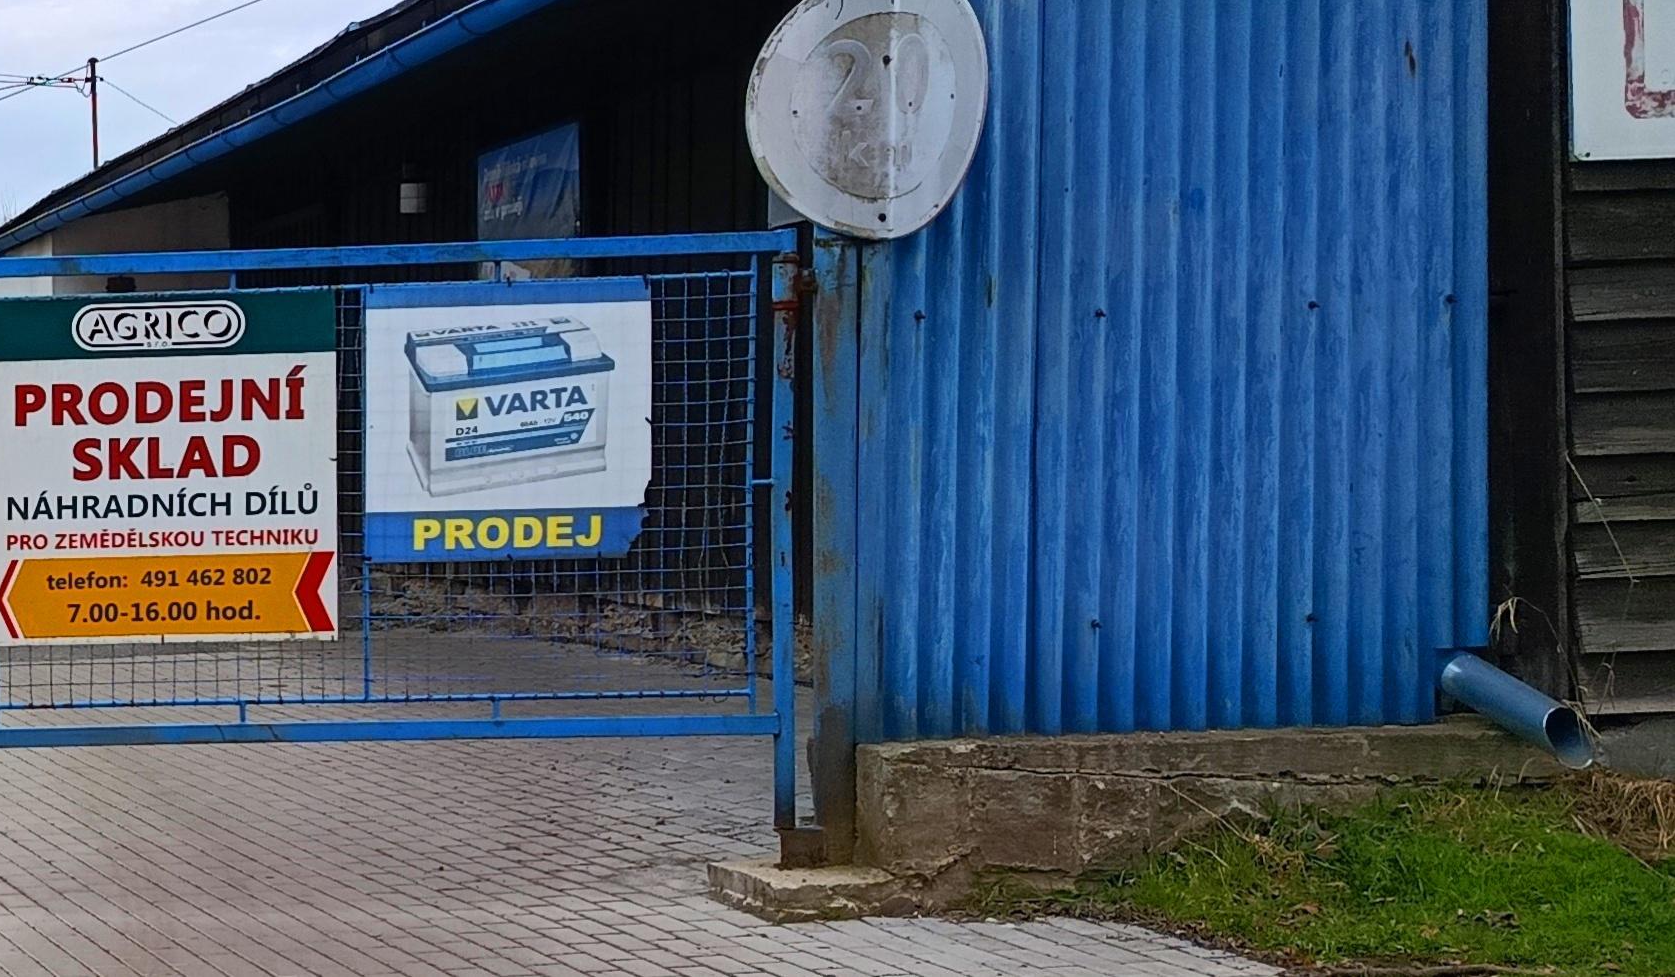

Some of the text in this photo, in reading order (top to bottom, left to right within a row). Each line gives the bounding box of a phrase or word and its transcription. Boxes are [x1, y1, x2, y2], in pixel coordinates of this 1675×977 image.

[86, 308, 233, 342] AGRICO
[432, 323, 501, 335] VARTA
[14, 365, 307, 427] PRODEJNÍ
[484, 385, 588, 417] VARTA
[455, 426, 479, 436] D24
[72, 434, 261, 482] SKLAD
[7, 483, 319, 520] NÁHRADNÍCH DÍLŮ
[6, 528, 319, 551] PRO ZEMĚDĚLSKOU TECHNIKU
[413, 515, 602, 551] PRODEJ
[46, 568, 271, 591] telefon: 491 462 802
[67, 600, 261, 623] 7.00-16.00 hod.
